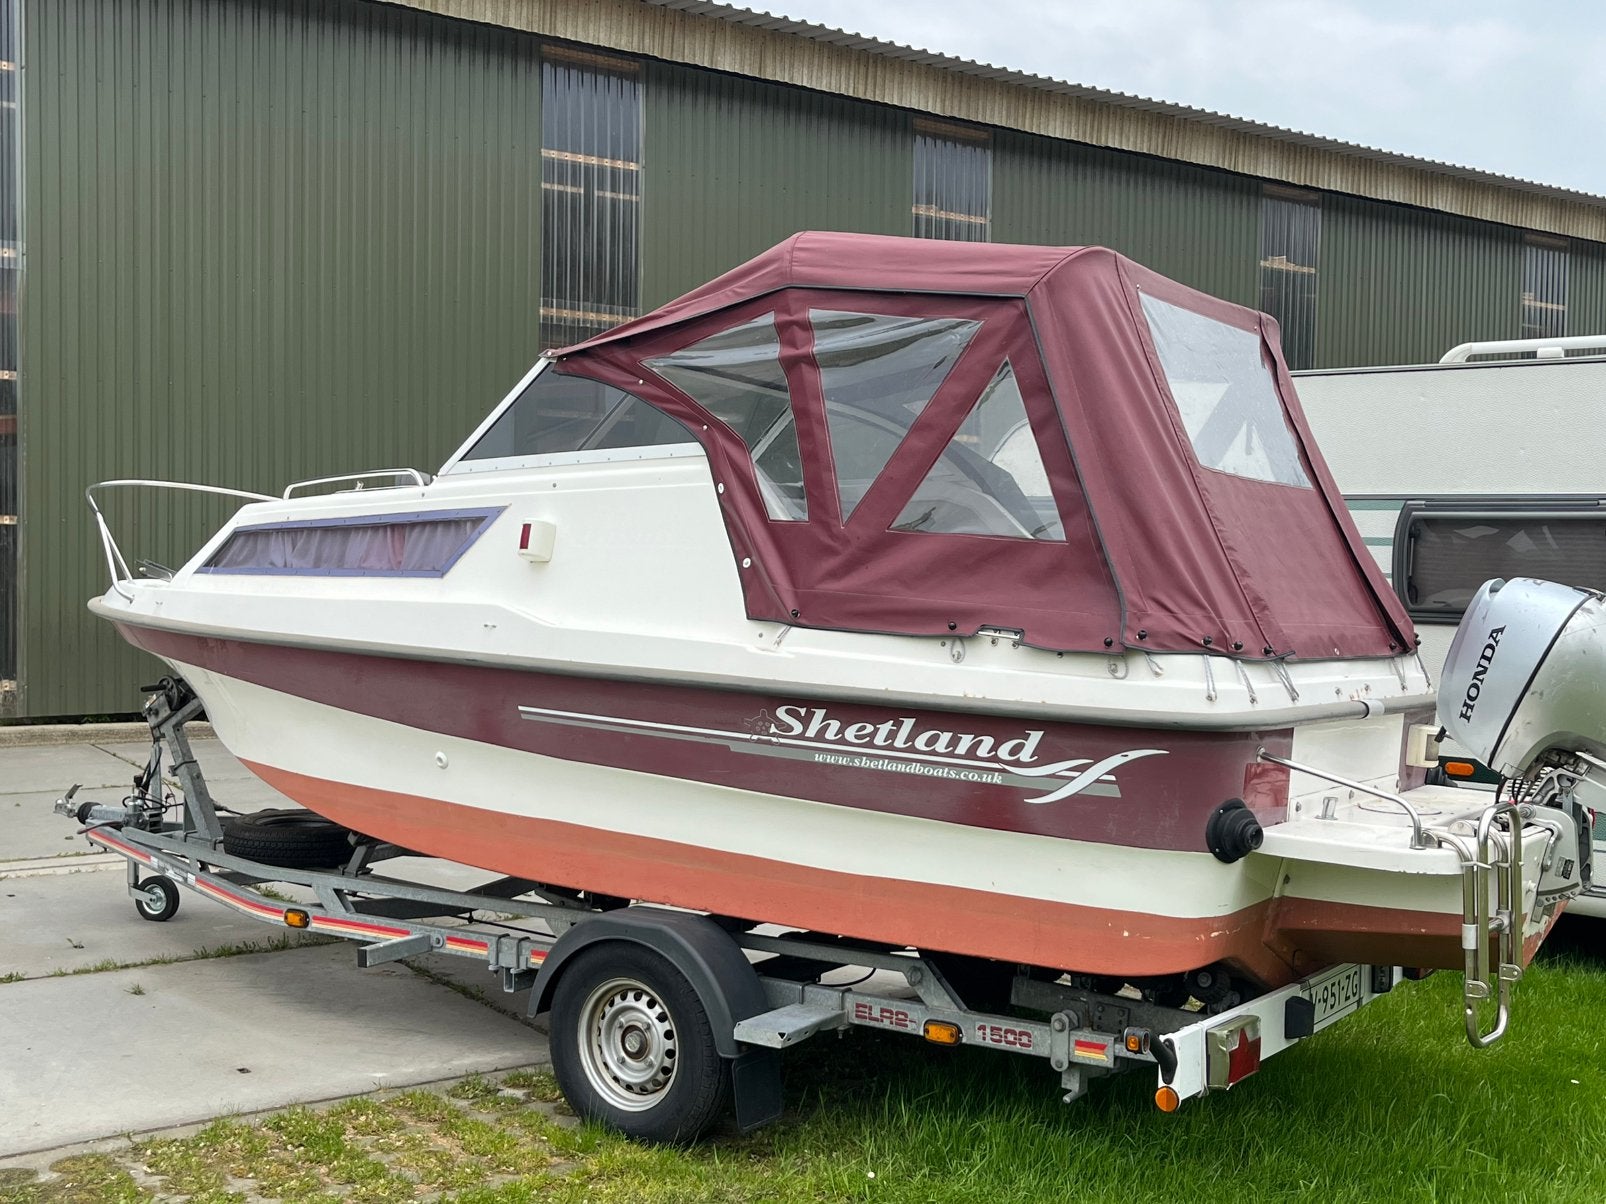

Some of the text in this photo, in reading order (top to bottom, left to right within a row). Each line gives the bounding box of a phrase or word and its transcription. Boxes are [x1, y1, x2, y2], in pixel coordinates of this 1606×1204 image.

[1459, 625, 1507, 723] HONDA
[769, 705, 1045, 763] Shetland
[814, 752, 1003, 784] www.shetlandboats.co.uk
[977, 1024, 1032, 1048] 1500
